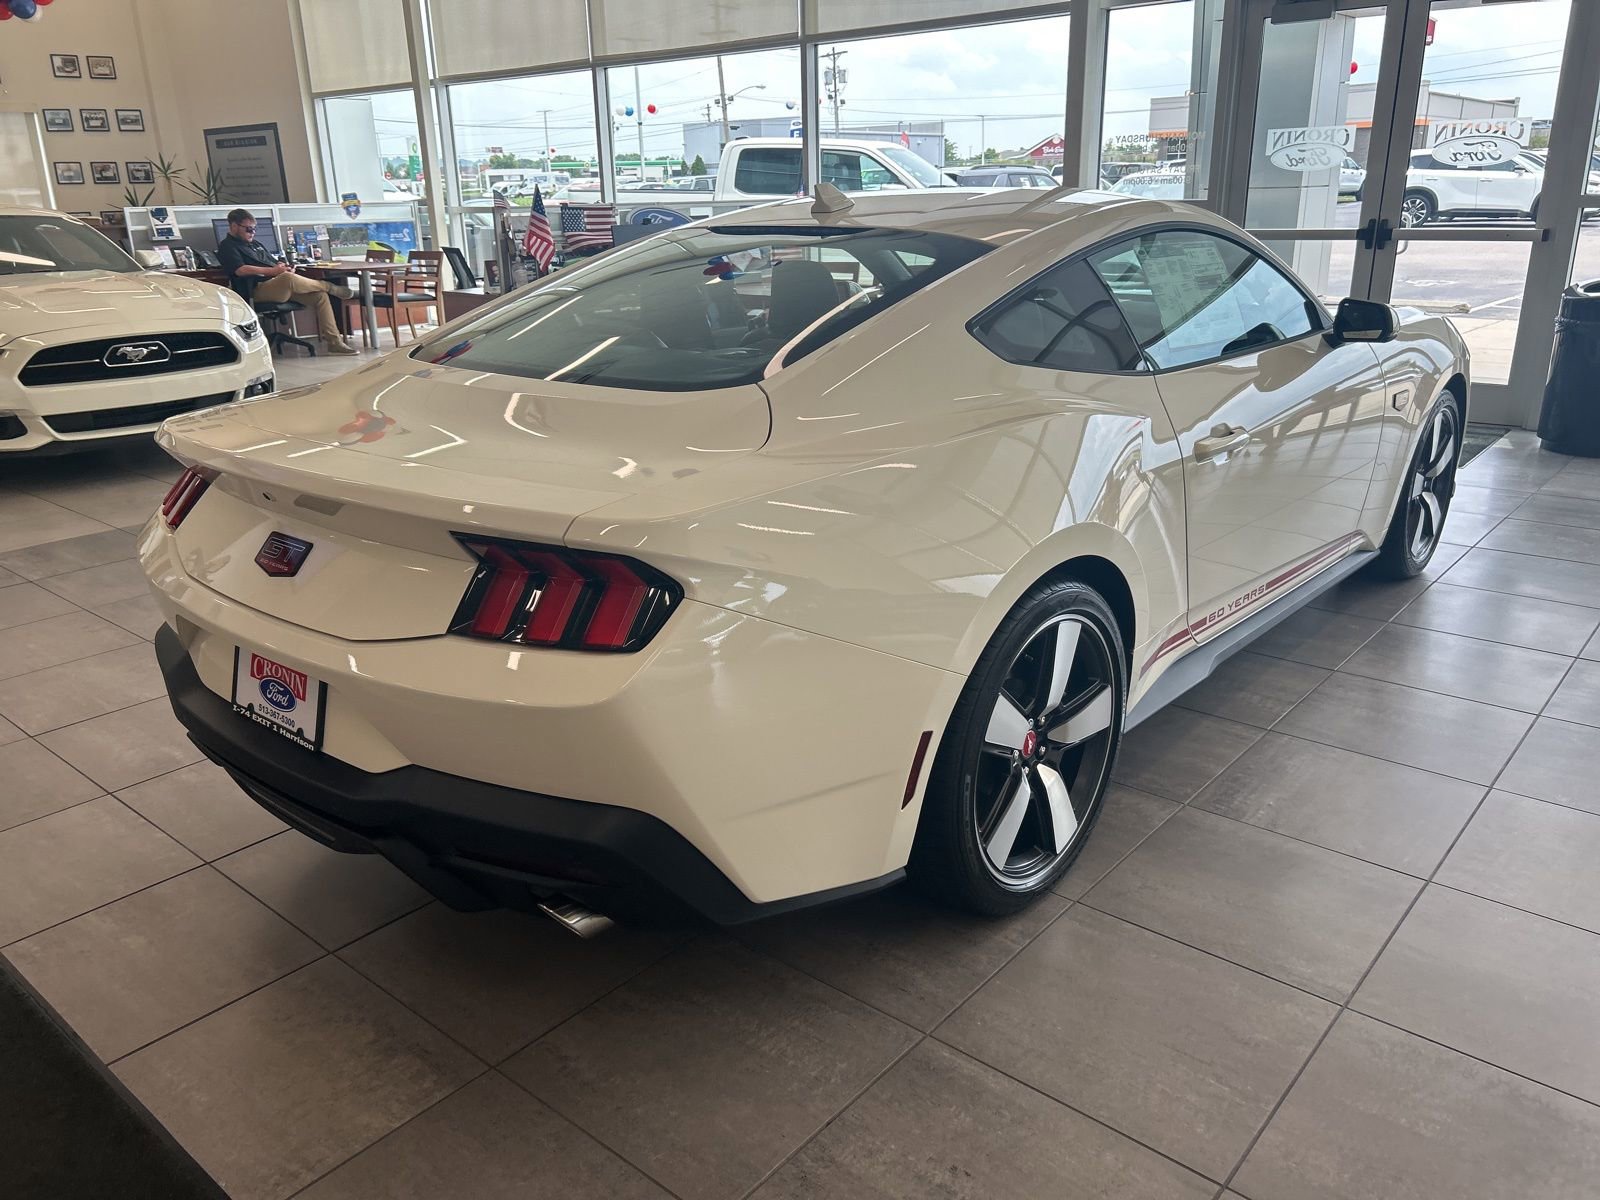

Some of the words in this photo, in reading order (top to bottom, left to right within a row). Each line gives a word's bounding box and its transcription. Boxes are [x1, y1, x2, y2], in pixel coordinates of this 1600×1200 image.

[262, 536, 306, 563] GT
[1208, 607, 1225, 622] 60
[1227, 584, 1265, 611] YEARS
[253, 656, 305, 700] CRONIN
[266, 682, 290, 706] Ford
[232, 704, 251, 717] I-74
[252, 713, 271, 727] EXIT
[272, 724, 278, 732] 1
[279, 727, 314, 751] Harrison
[258, 703, 295, 728] 513-367-5300
